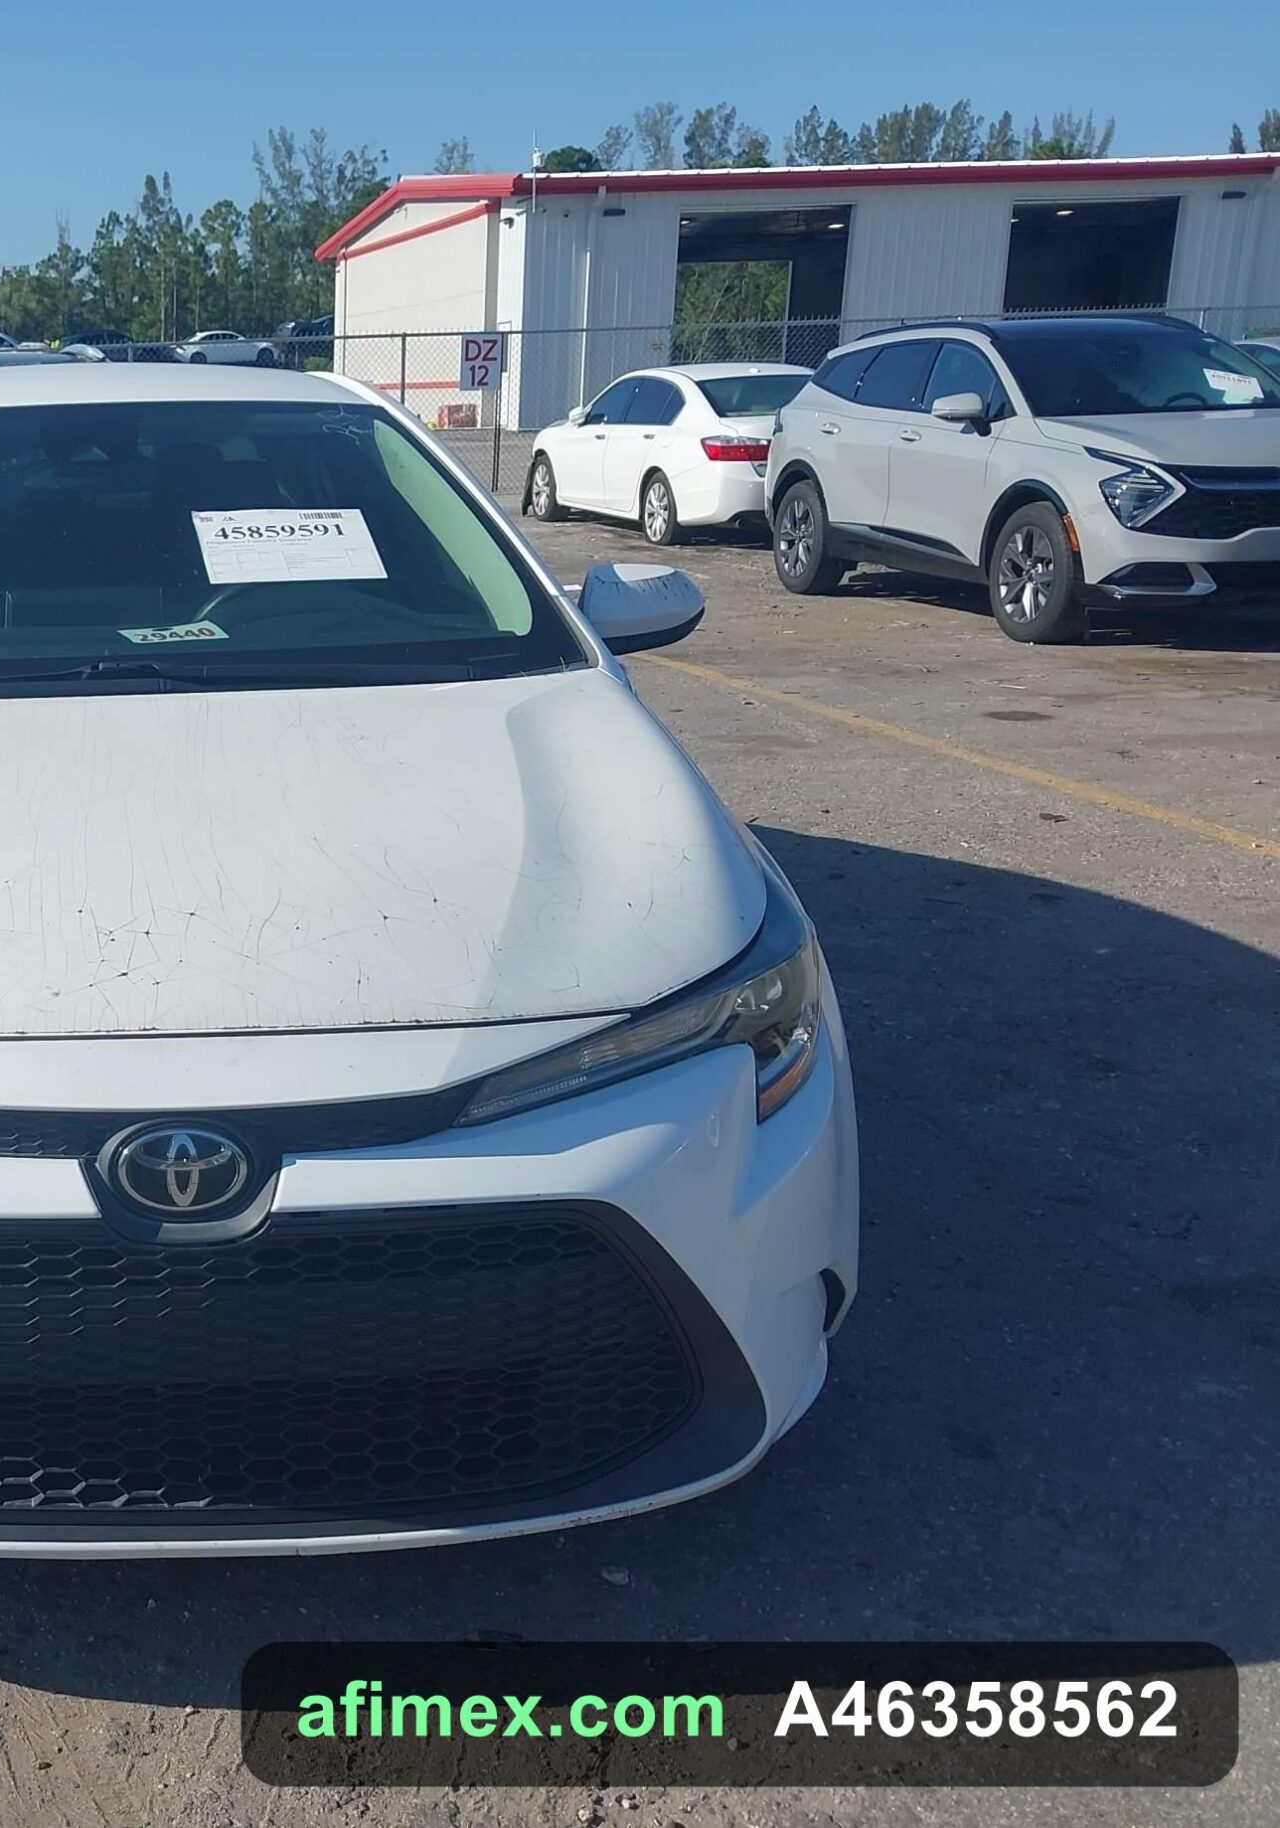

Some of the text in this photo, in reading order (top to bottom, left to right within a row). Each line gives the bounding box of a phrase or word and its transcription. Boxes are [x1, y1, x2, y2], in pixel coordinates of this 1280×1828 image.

[465, 339, 498, 361] DZ
[469, 365, 489, 386] 12
[214, 523, 345, 540] 45859591
[134, 627, 216, 642] 29440
